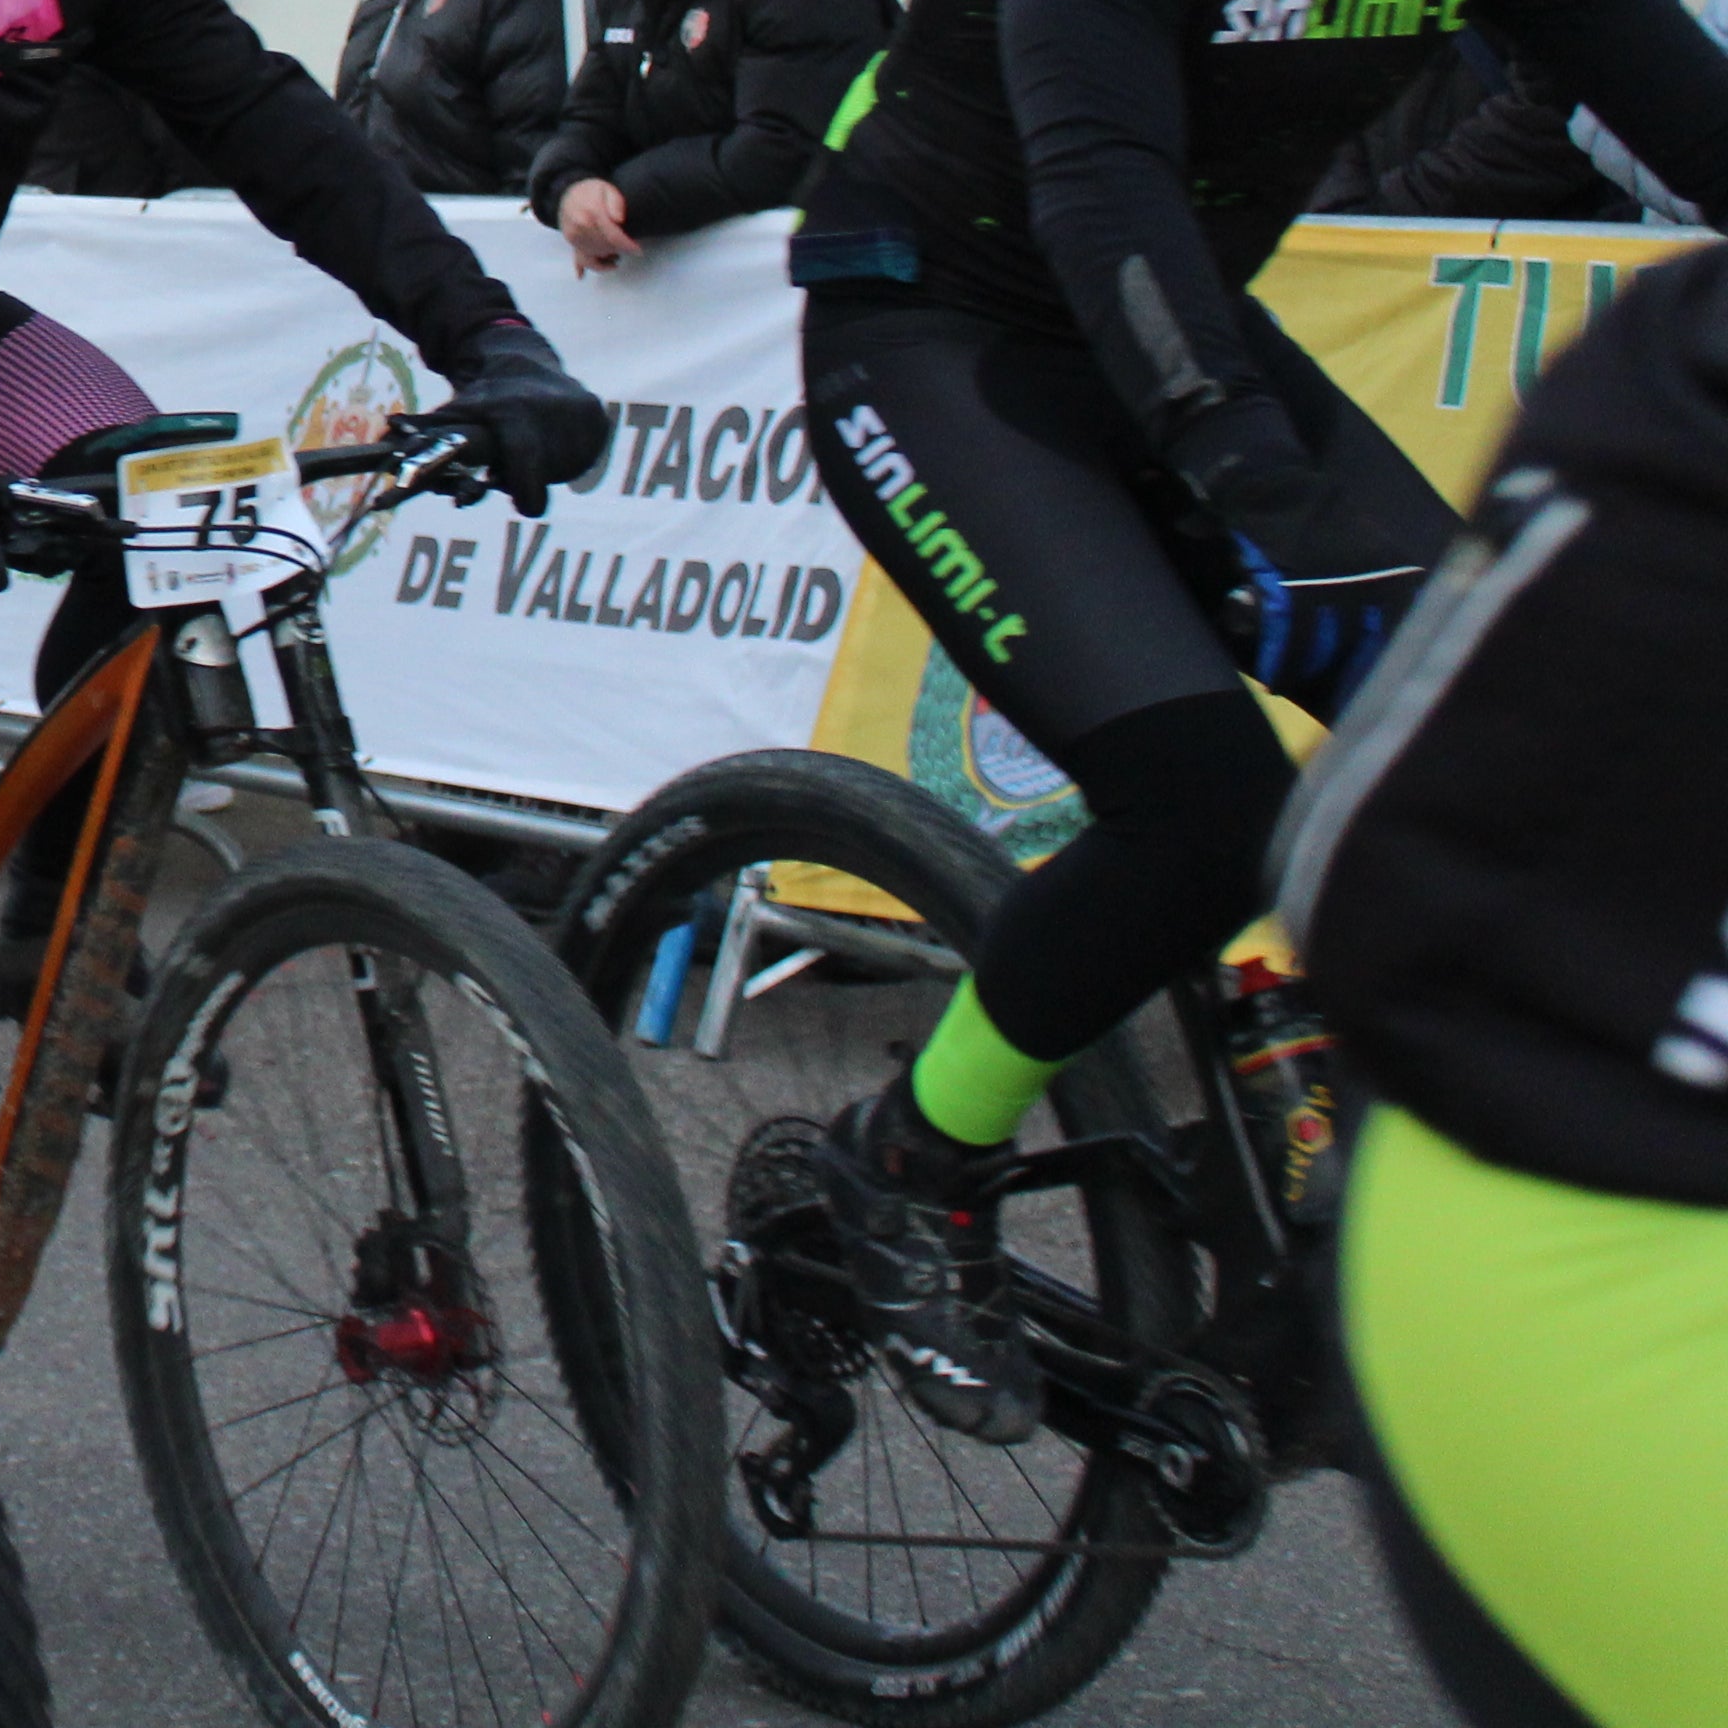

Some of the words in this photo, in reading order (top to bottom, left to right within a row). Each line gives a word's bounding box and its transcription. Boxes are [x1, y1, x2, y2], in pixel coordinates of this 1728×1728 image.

[179, 484, 259, 547] 75
[396, 534, 478, 609] DE
[495, 520, 842, 643] VALLADOLID
